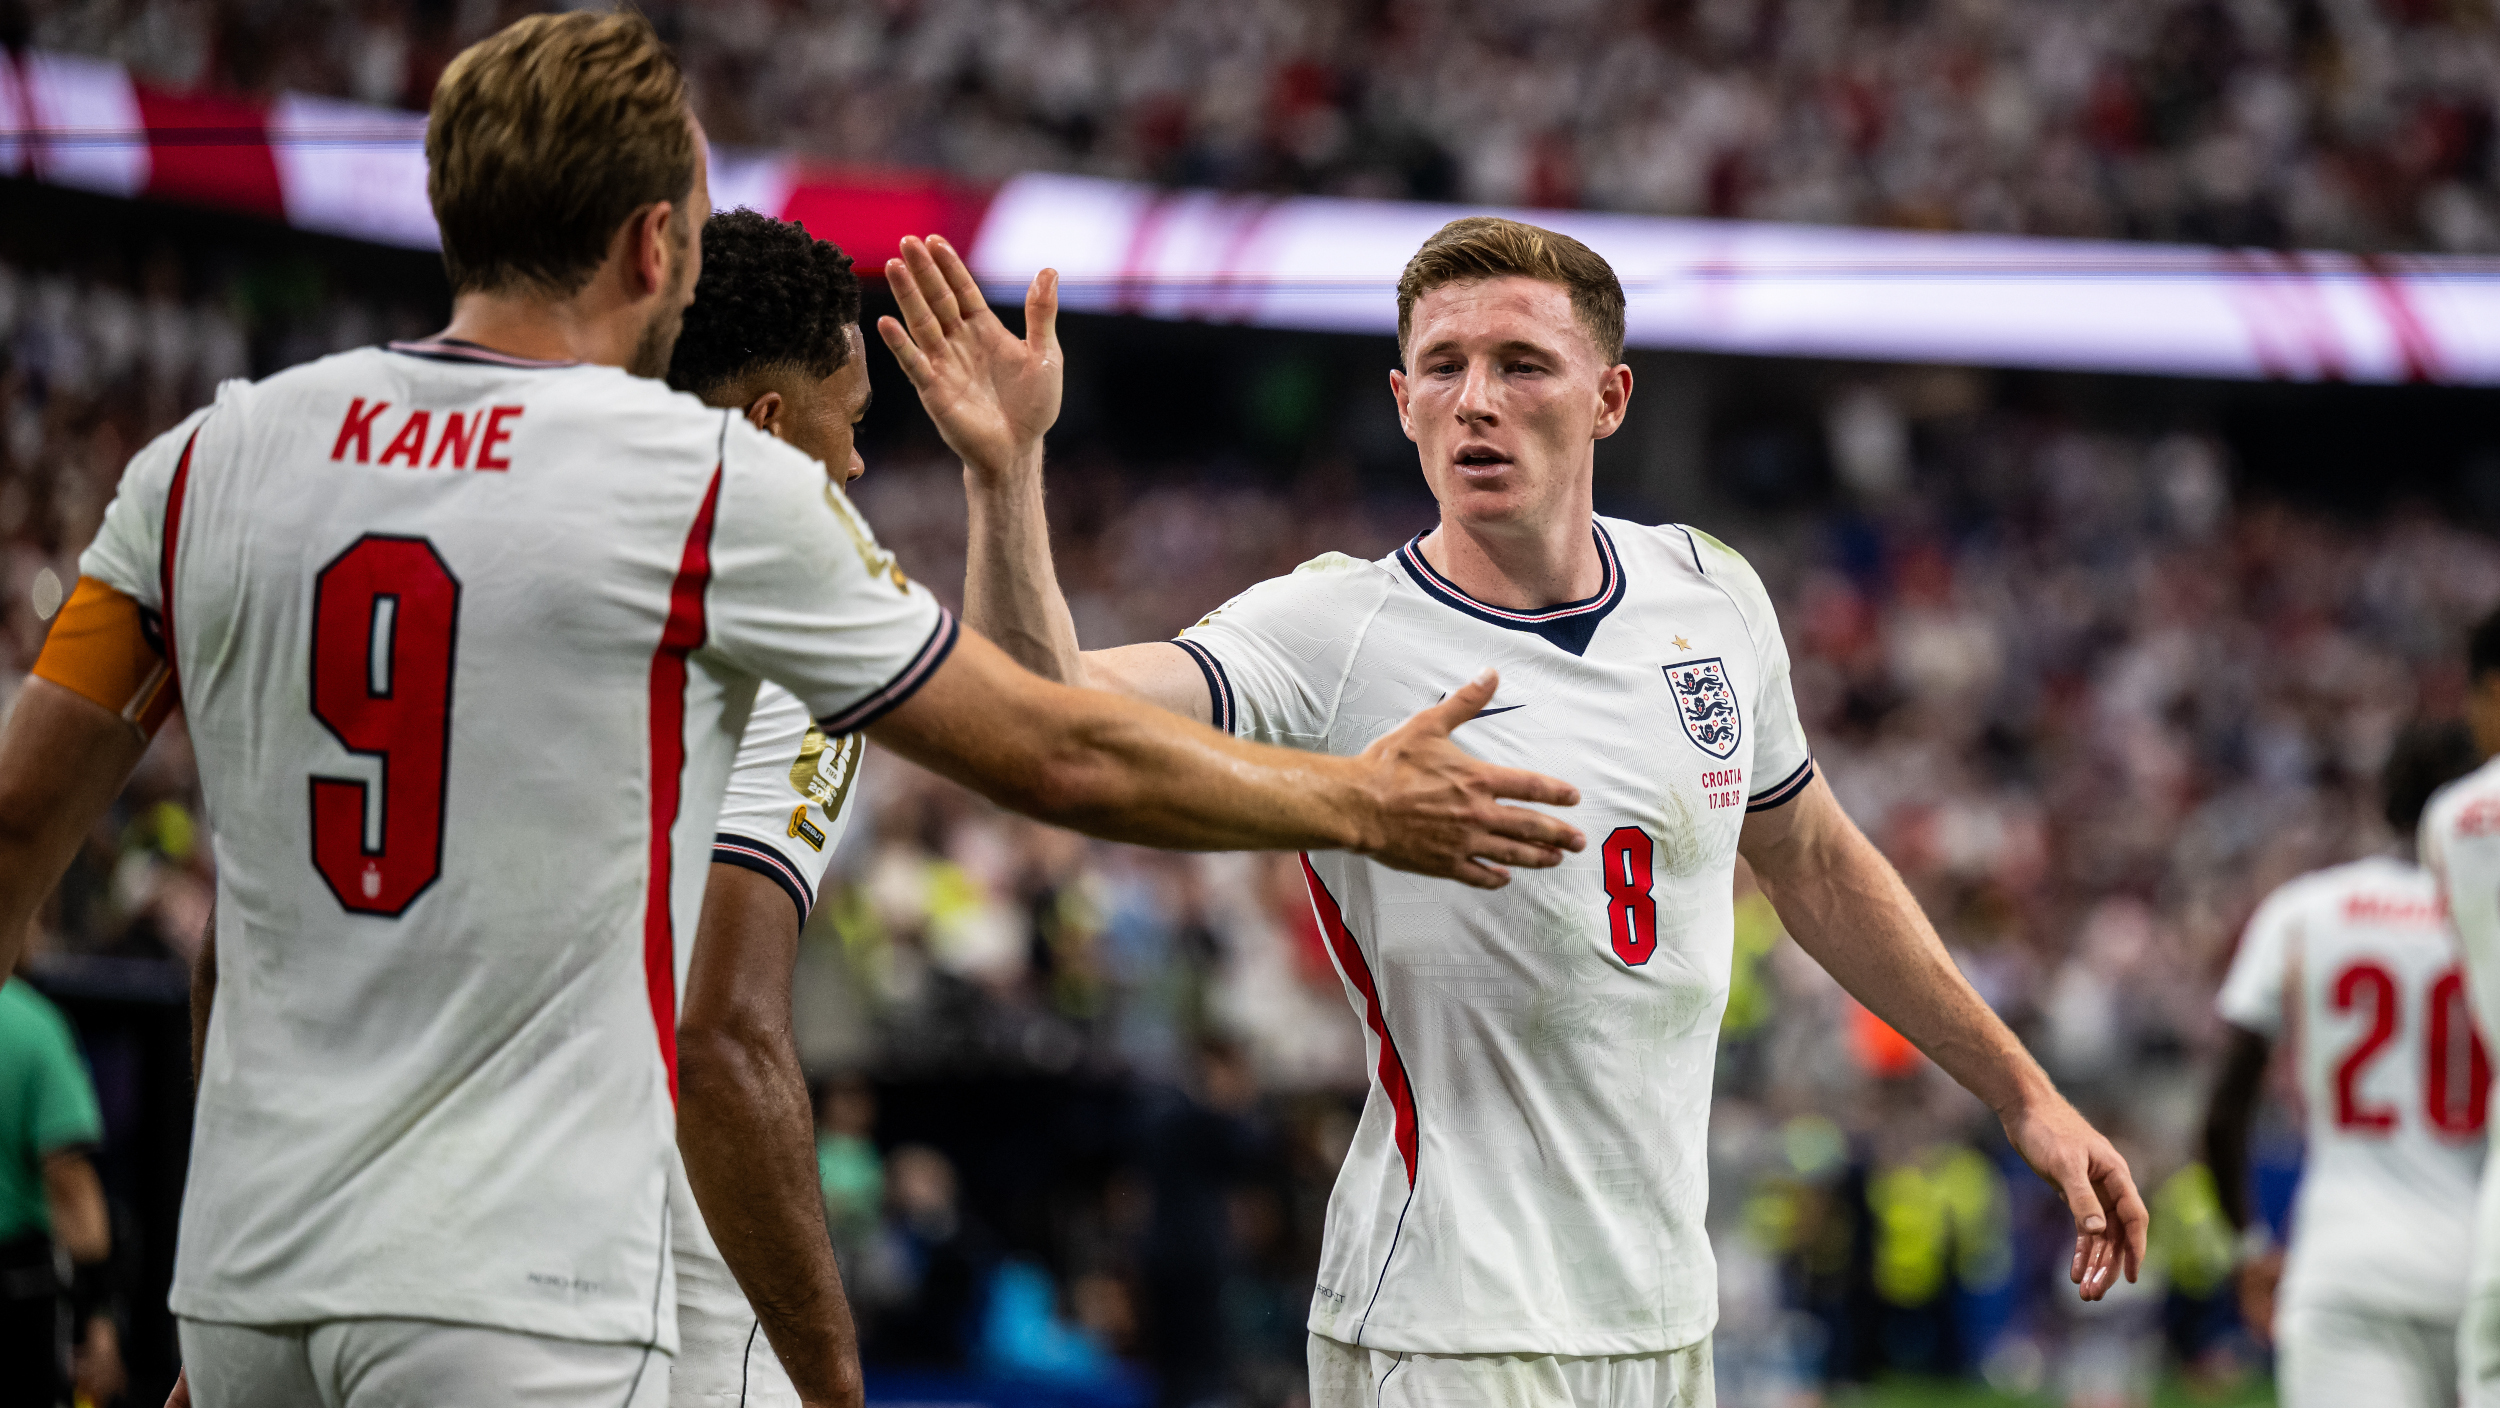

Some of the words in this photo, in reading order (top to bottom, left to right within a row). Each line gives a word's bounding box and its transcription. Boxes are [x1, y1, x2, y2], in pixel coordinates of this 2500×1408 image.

[330, 397, 525, 473] KANE
[309, 531, 461, 919] 9
[825, 766, 838, 781] FIFA
[1702, 768, 1742, 789] CROATIA
[1709, 789, 1740, 810] 17.06.26
[801, 820, 825, 842] DEBUT
[1601, 825, 1658, 967] 8
[2334, 960, 2492, 1140] 20
